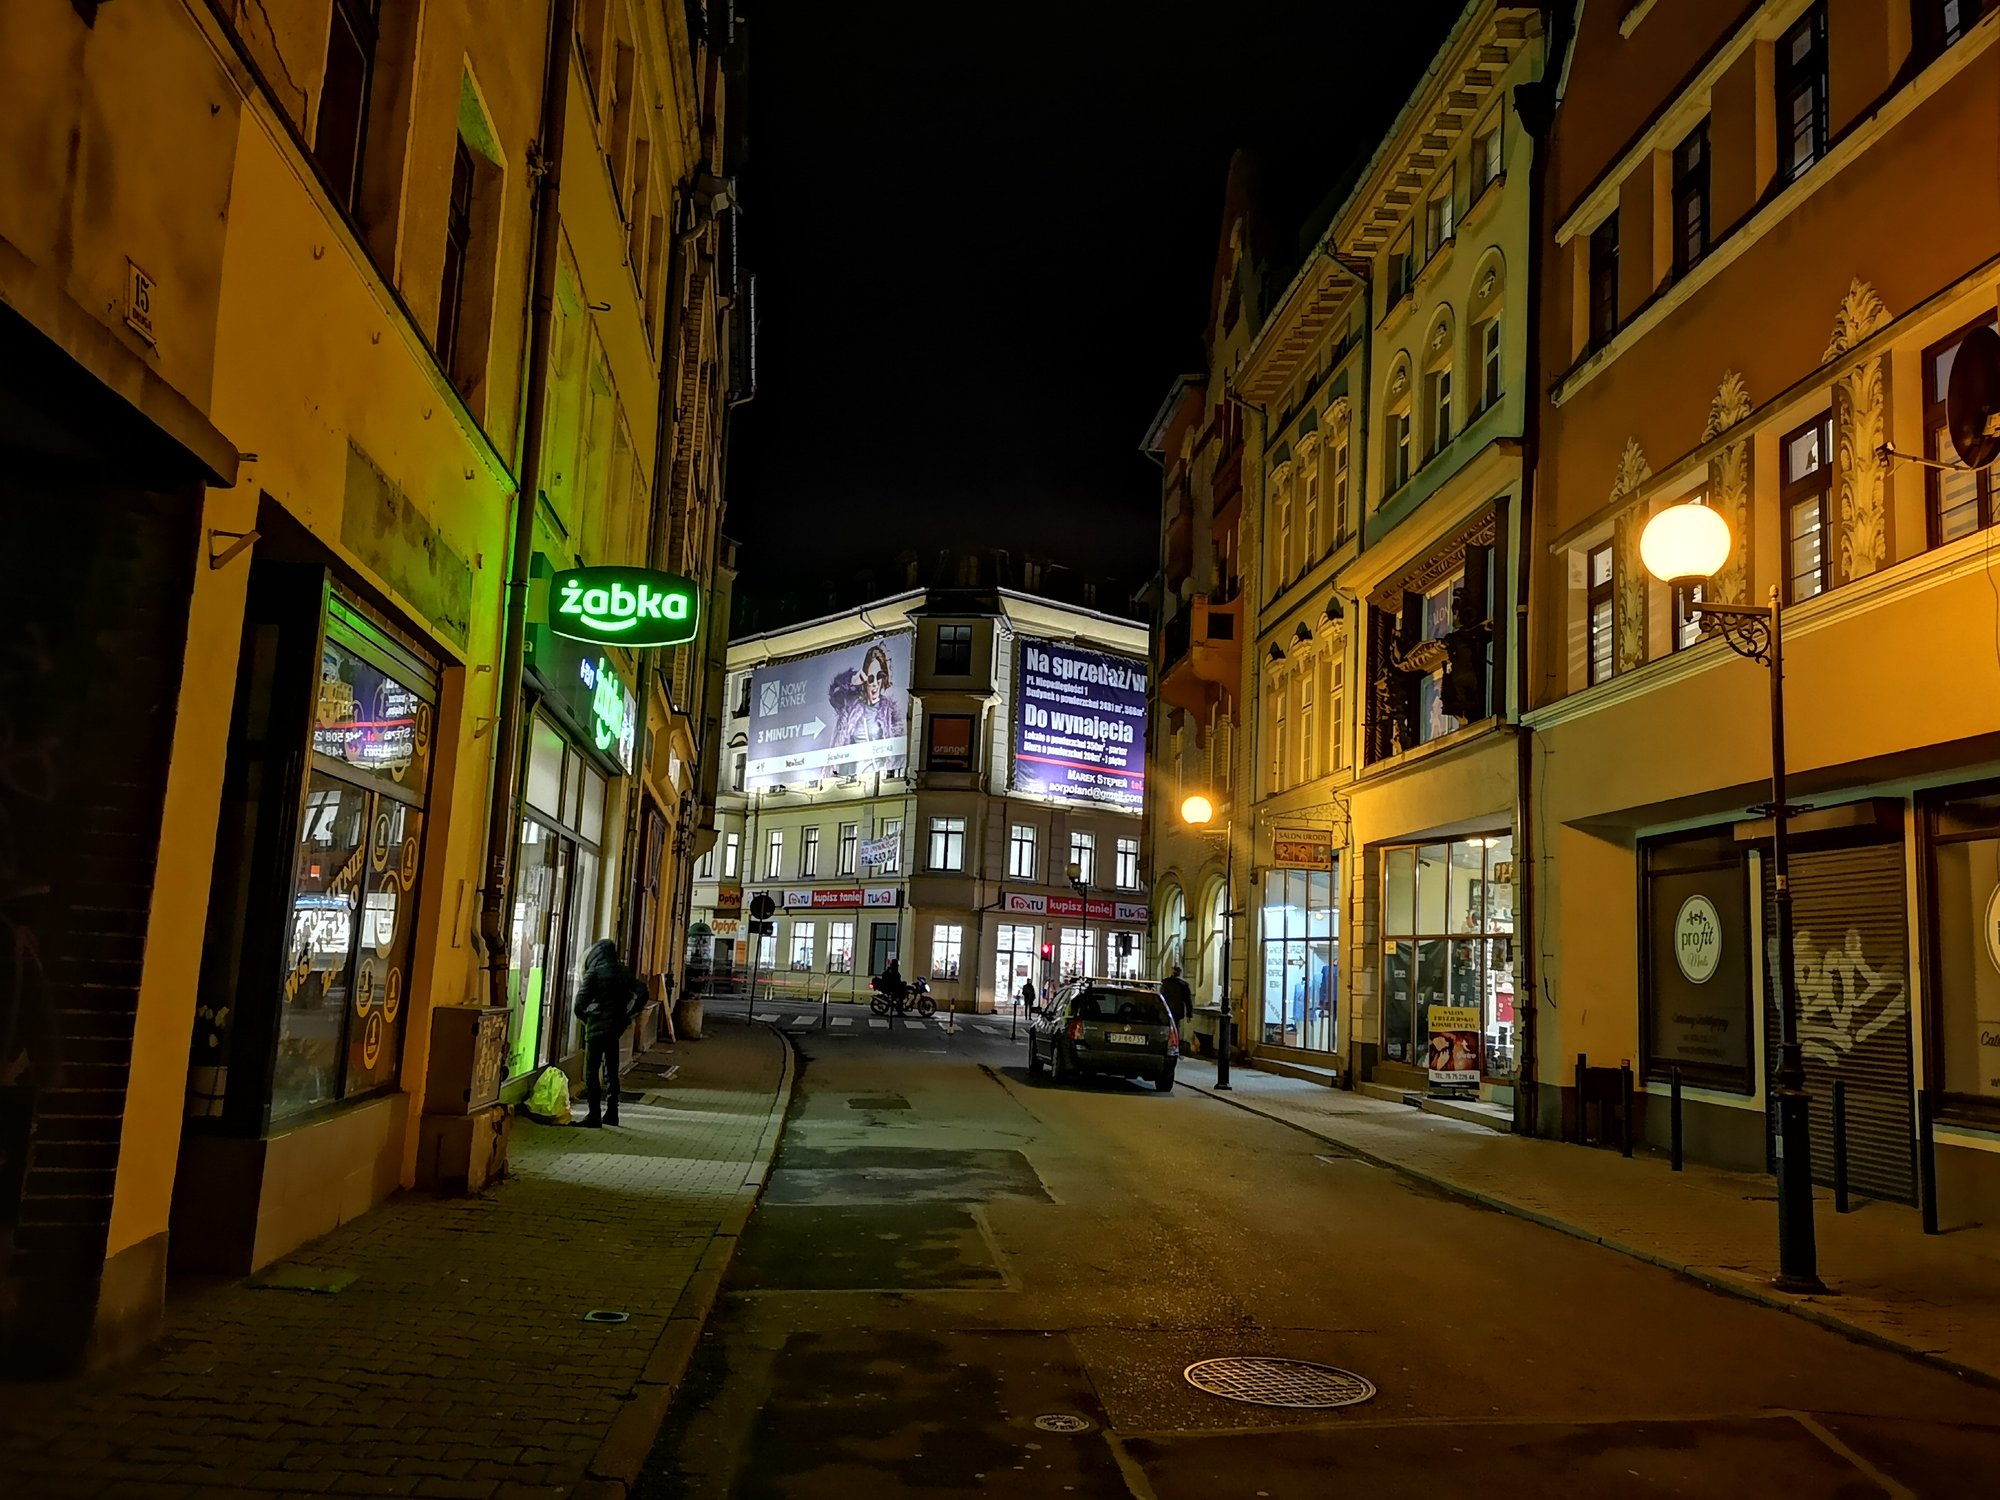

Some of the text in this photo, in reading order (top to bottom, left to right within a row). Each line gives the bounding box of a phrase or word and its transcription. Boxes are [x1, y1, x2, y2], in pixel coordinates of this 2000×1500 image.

[135, 273, 150, 313] 15
[559, 579, 688, 620] żabka
[1026, 647, 1050, 674] Na
[781, 680, 807, 695] NOWY
[780, 693, 806, 708] RYNEK
[1025, 703, 1134, 743] Do wynajęcia
[757, 724, 801, 744] 3 MINUTY
[934, 746, 966, 755] orange
[1131, 780, 1144, 791] tel.
[1279, 832, 1328, 842] SALON URODY
[719, 894, 740, 905] Optyk
[813, 892, 838, 908] kupisz
[839, 889, 863, 904] taniej
[1050, 899, 1083, 913] kupisz
[1085, 903, 1113, 917] taniej
[712, 920, 737, 934] Optyk
[1681, 921, 1714, 952] profit
[1431, 1021, 1476, 1029] KOSMETYCZNY
